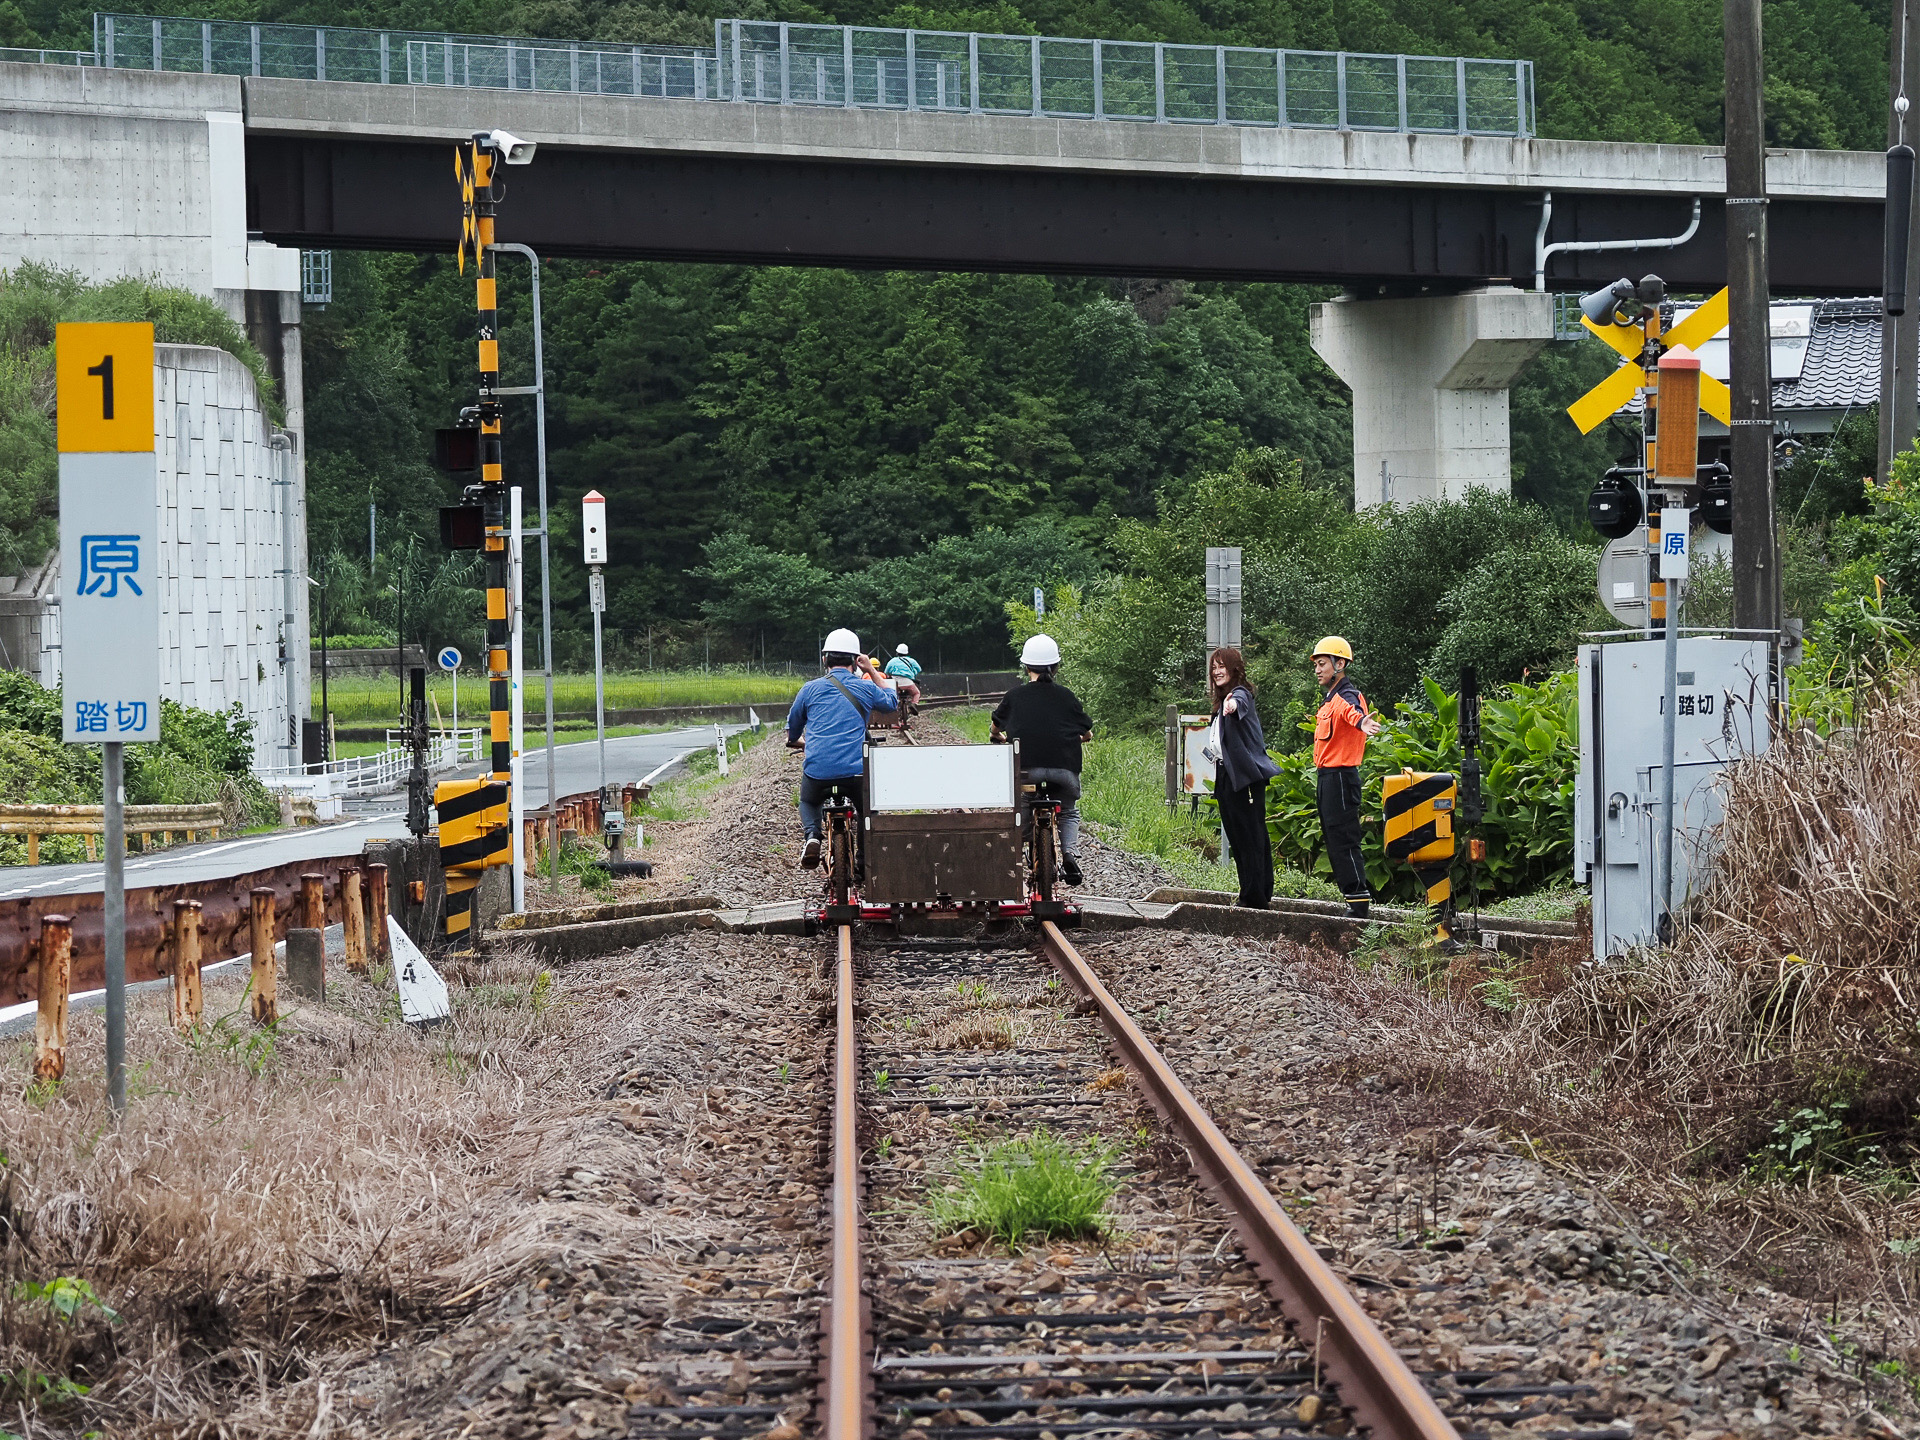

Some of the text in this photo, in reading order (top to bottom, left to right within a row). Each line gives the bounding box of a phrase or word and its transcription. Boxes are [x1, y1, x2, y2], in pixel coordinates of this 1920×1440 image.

[87, 354, 115, 421] 1
[76, 534, 143, 598] 原
[1663, 532, 1686, 556] 原
[75, 699, 148, 733] 踏切
